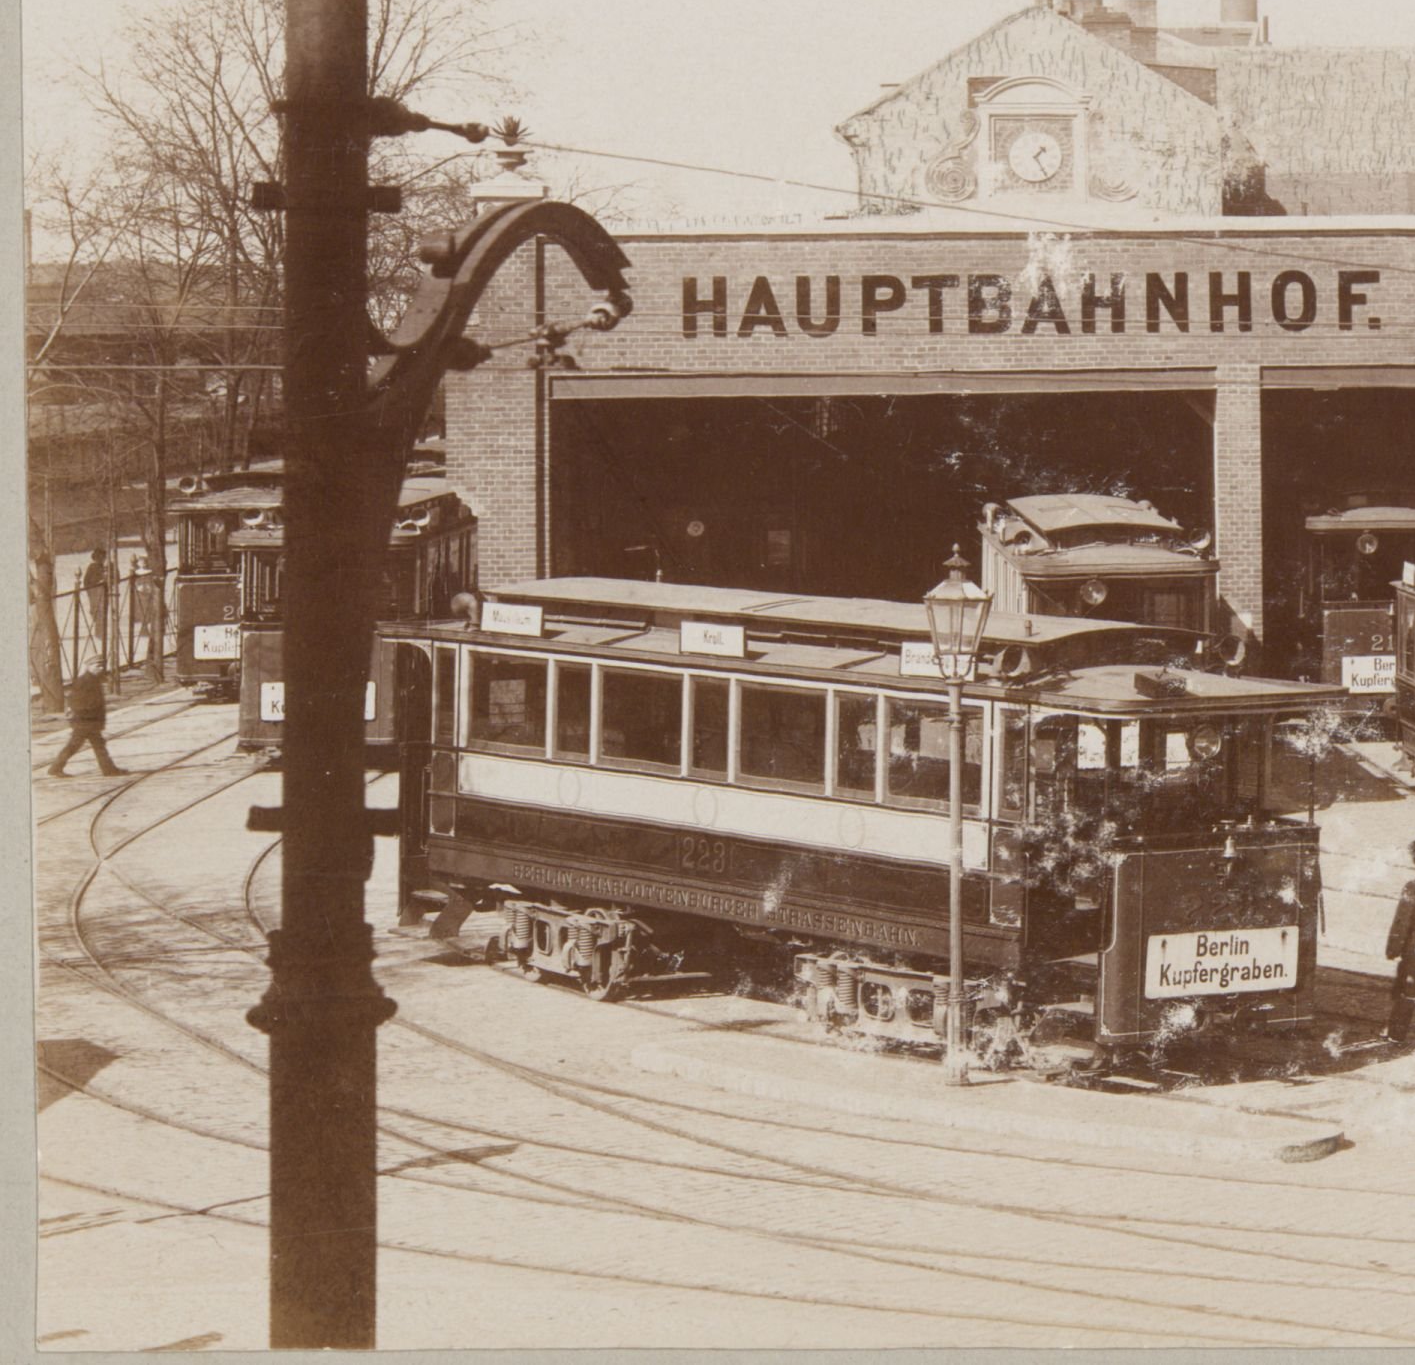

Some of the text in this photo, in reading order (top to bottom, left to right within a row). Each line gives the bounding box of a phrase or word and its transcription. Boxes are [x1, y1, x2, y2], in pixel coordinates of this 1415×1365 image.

[681, 270, 1381, 338] HAUPTBAHNHOF.
[681, 835, 726, 874] 223
[1195, 934, 1250, 957] Berlin
[1159, 958, 1288, 989] Kupfergraben.
